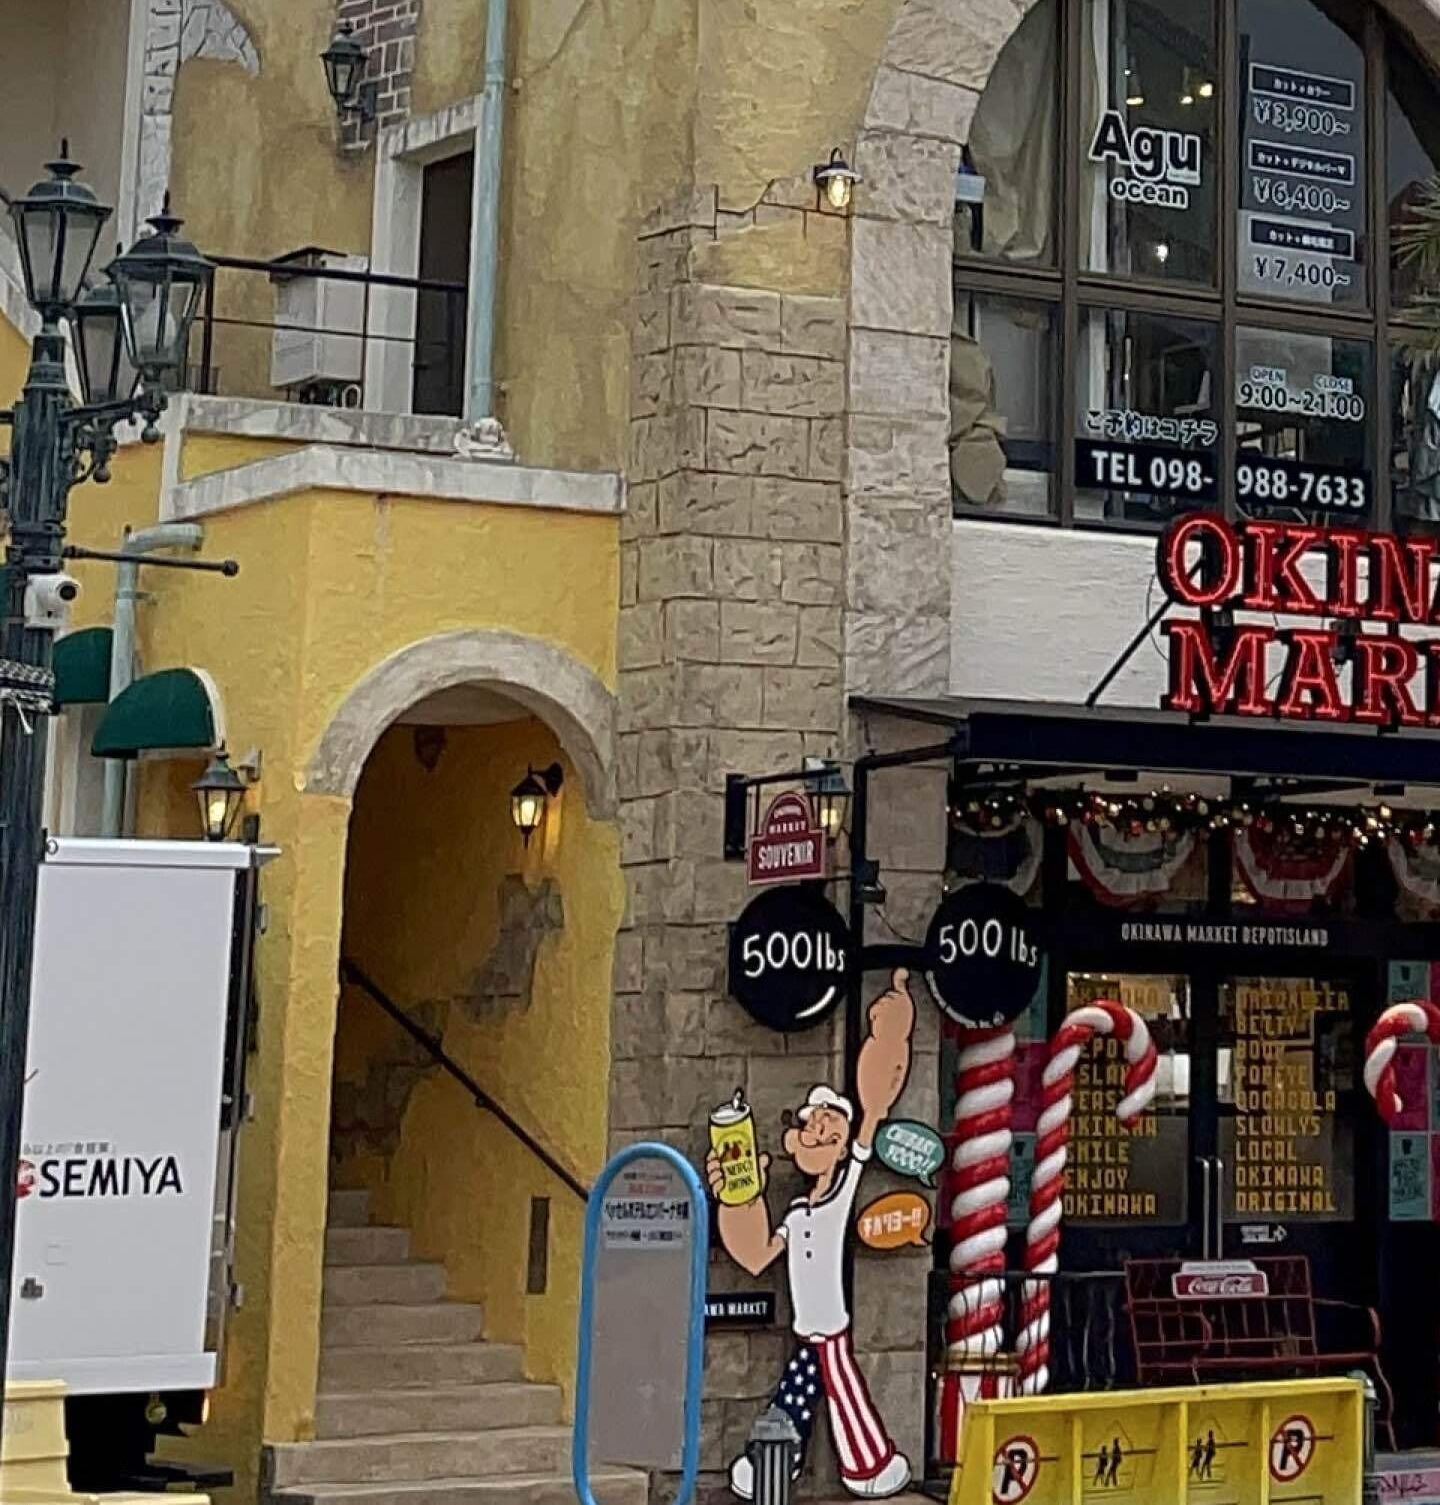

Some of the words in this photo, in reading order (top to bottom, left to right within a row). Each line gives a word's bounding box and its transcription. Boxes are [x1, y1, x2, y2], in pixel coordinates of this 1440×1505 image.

[1089, 109, 1200, 182] Agu
[1111, 177, 1189, 209] ocean
[1250, 366, 1286, 384] OPEN
[1314, 374, 1352, 393] CLOSE
[1086, 409, 1219, 445] ご予約はコチラ
[1090, 449, 1142, 485] TEL
[1150, 457, 1213, 491] 098-
[1236, 465, 1365, 508] 988-7633
[758, 840, 814, 870] SOUVENIR
[1121, 923, 1182, 941] OKINAWA
[1187, 924, 1237, 944] MARKET
[1242, 926, 1328, 947] DEPOTISLAND
[1235, 1140, 1297, 1161] LOCAL
[39, 1156, 184, 1197] SEMIYA
[1064, 1168, 1129, 1190] ENJOY
[1235, 1166, 1324, 1187] OKINAWA
[1063, 1194, 1158, 1216] OKINAWA
[1235, 1192, 1337, 1212] ORIGINAL
